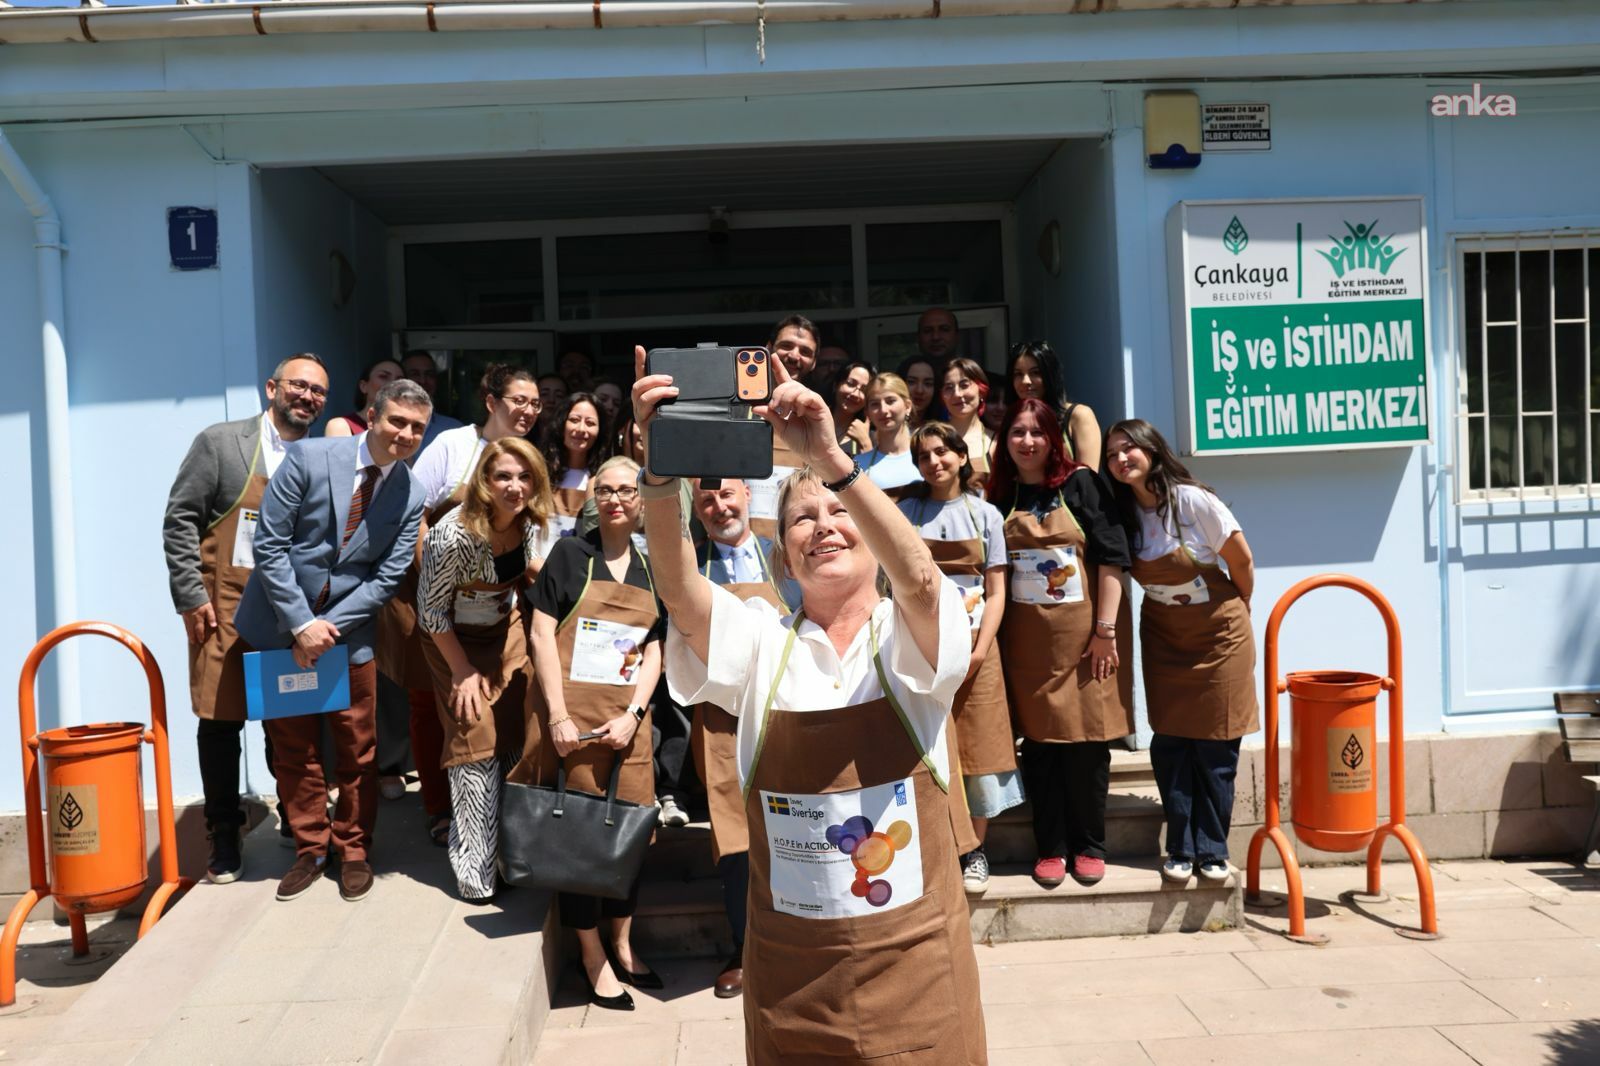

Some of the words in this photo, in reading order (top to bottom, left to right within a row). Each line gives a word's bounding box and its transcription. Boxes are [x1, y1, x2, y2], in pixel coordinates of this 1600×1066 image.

[187, 221, 197, 251] 1
[1194, 263, 1288, 287] Çankaya
[1330, 280, 1340, 289] İŞ
[1357, 278, 1404, 286] İSTİHDAM
[1212, 290, 1272, 301] BELEDİYESİ
[1328, 289, 1360, 298] EĞİTİM
[1363, 288, 1407, 296] MERKEZİ
[1211, 319, 1239, 384] İŞ
[1244, 337, 1277, 370] ve
[1283, 313, 1414, 368] İSTİHDAM
[1206, 384, 1298, 440] EĞİTİM
[1305, 374, 1427, 433] MERKEZİ
[791, 807, 825, 820] Sverige
[804, 841, 837, 850] ACTION
